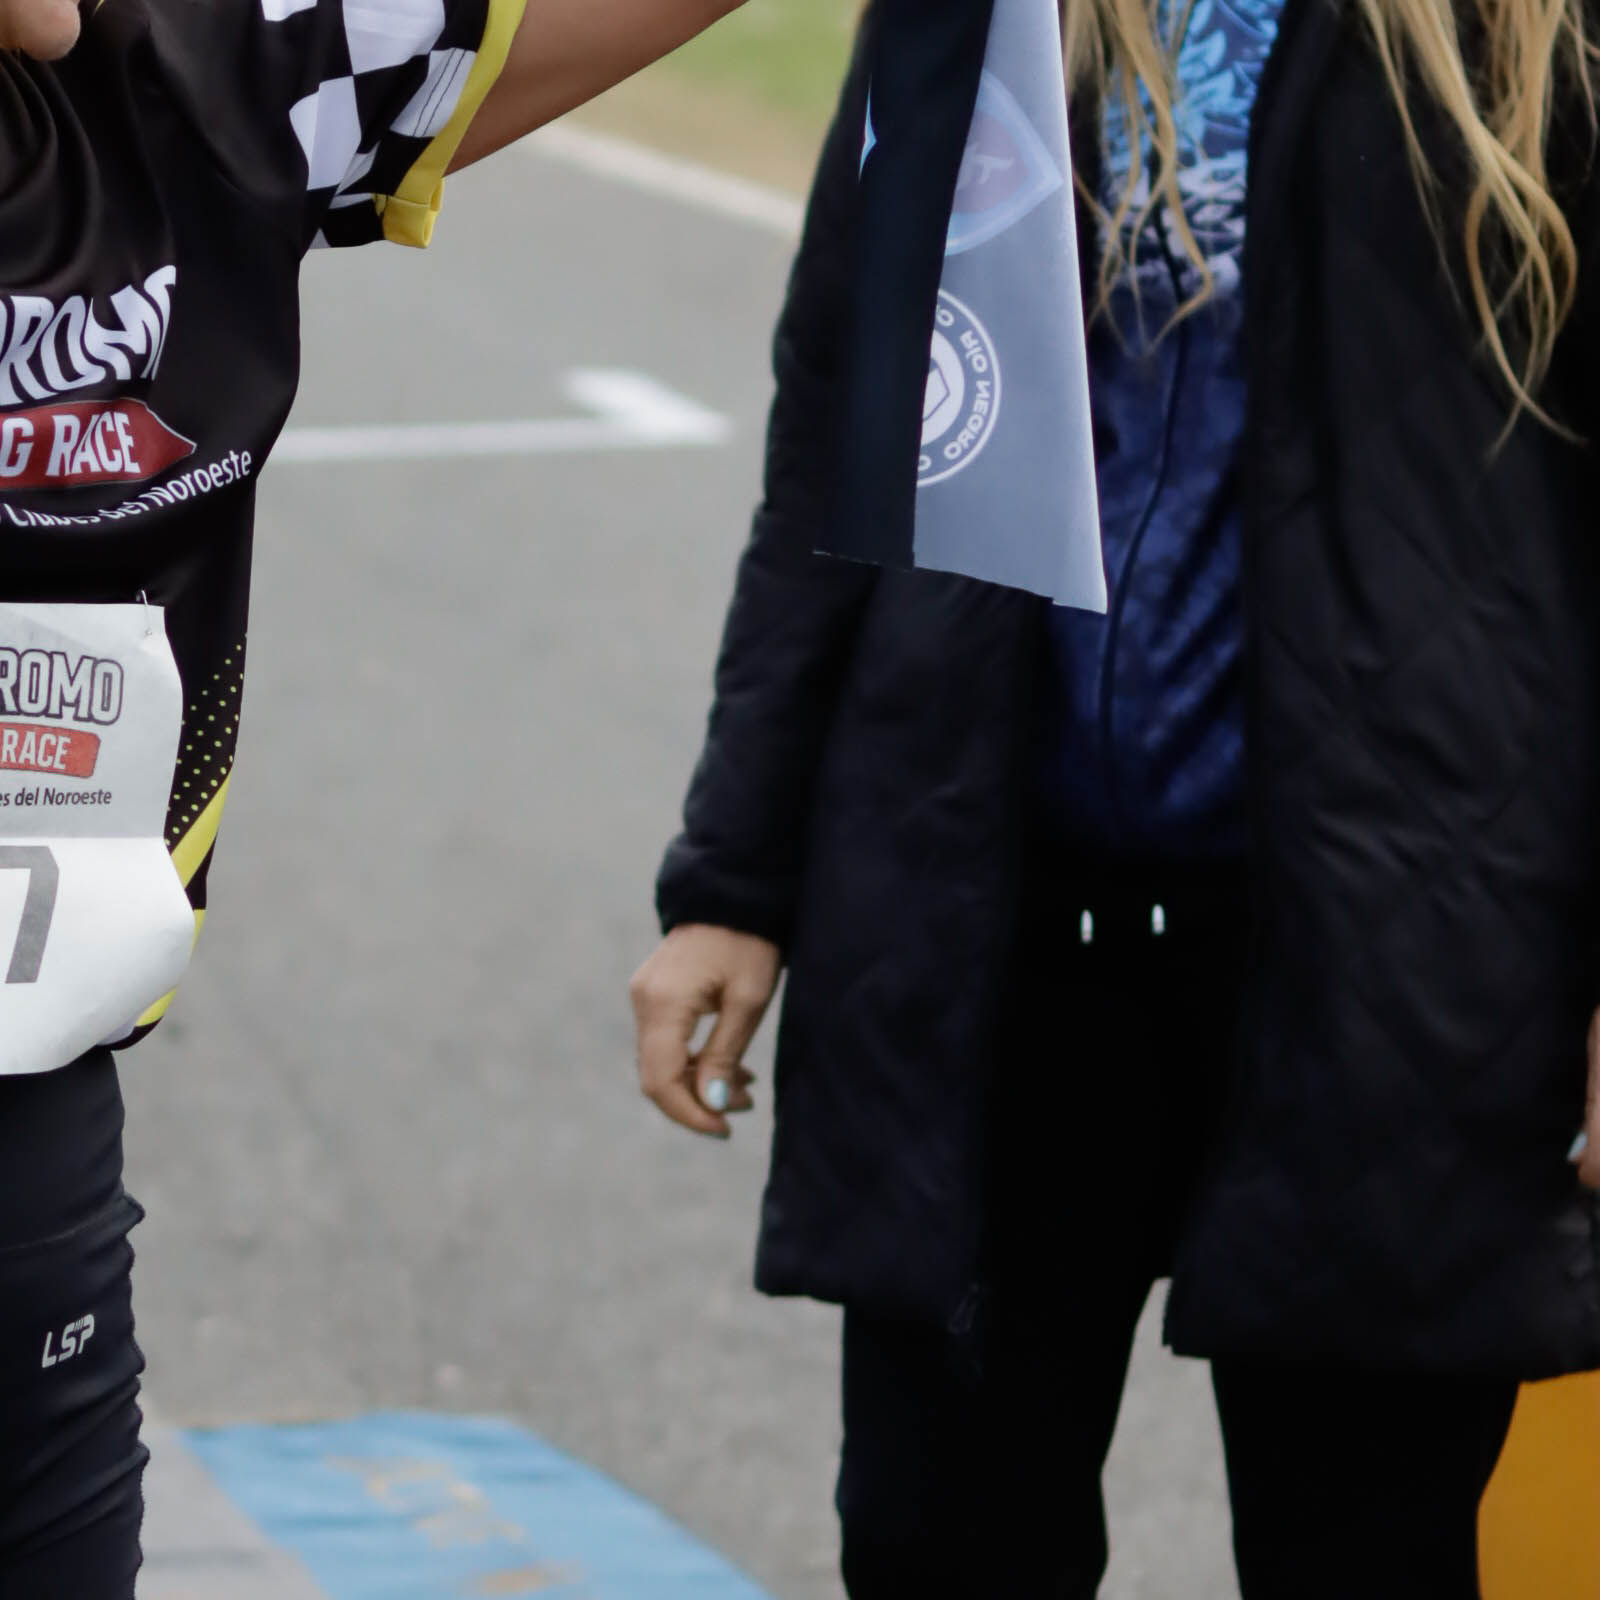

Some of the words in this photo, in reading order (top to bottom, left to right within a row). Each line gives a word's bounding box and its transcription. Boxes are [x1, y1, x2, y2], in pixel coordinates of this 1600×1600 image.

[46, 411, 142, 477] RACE
[138, 449, 252, 509] Noroeste
[0, 728, 72, 771] RACE
[15, 787, 40, 807] del
[42, 787, 113, 807] Noroeste
[41, 1313, 96, 1369] LSP
